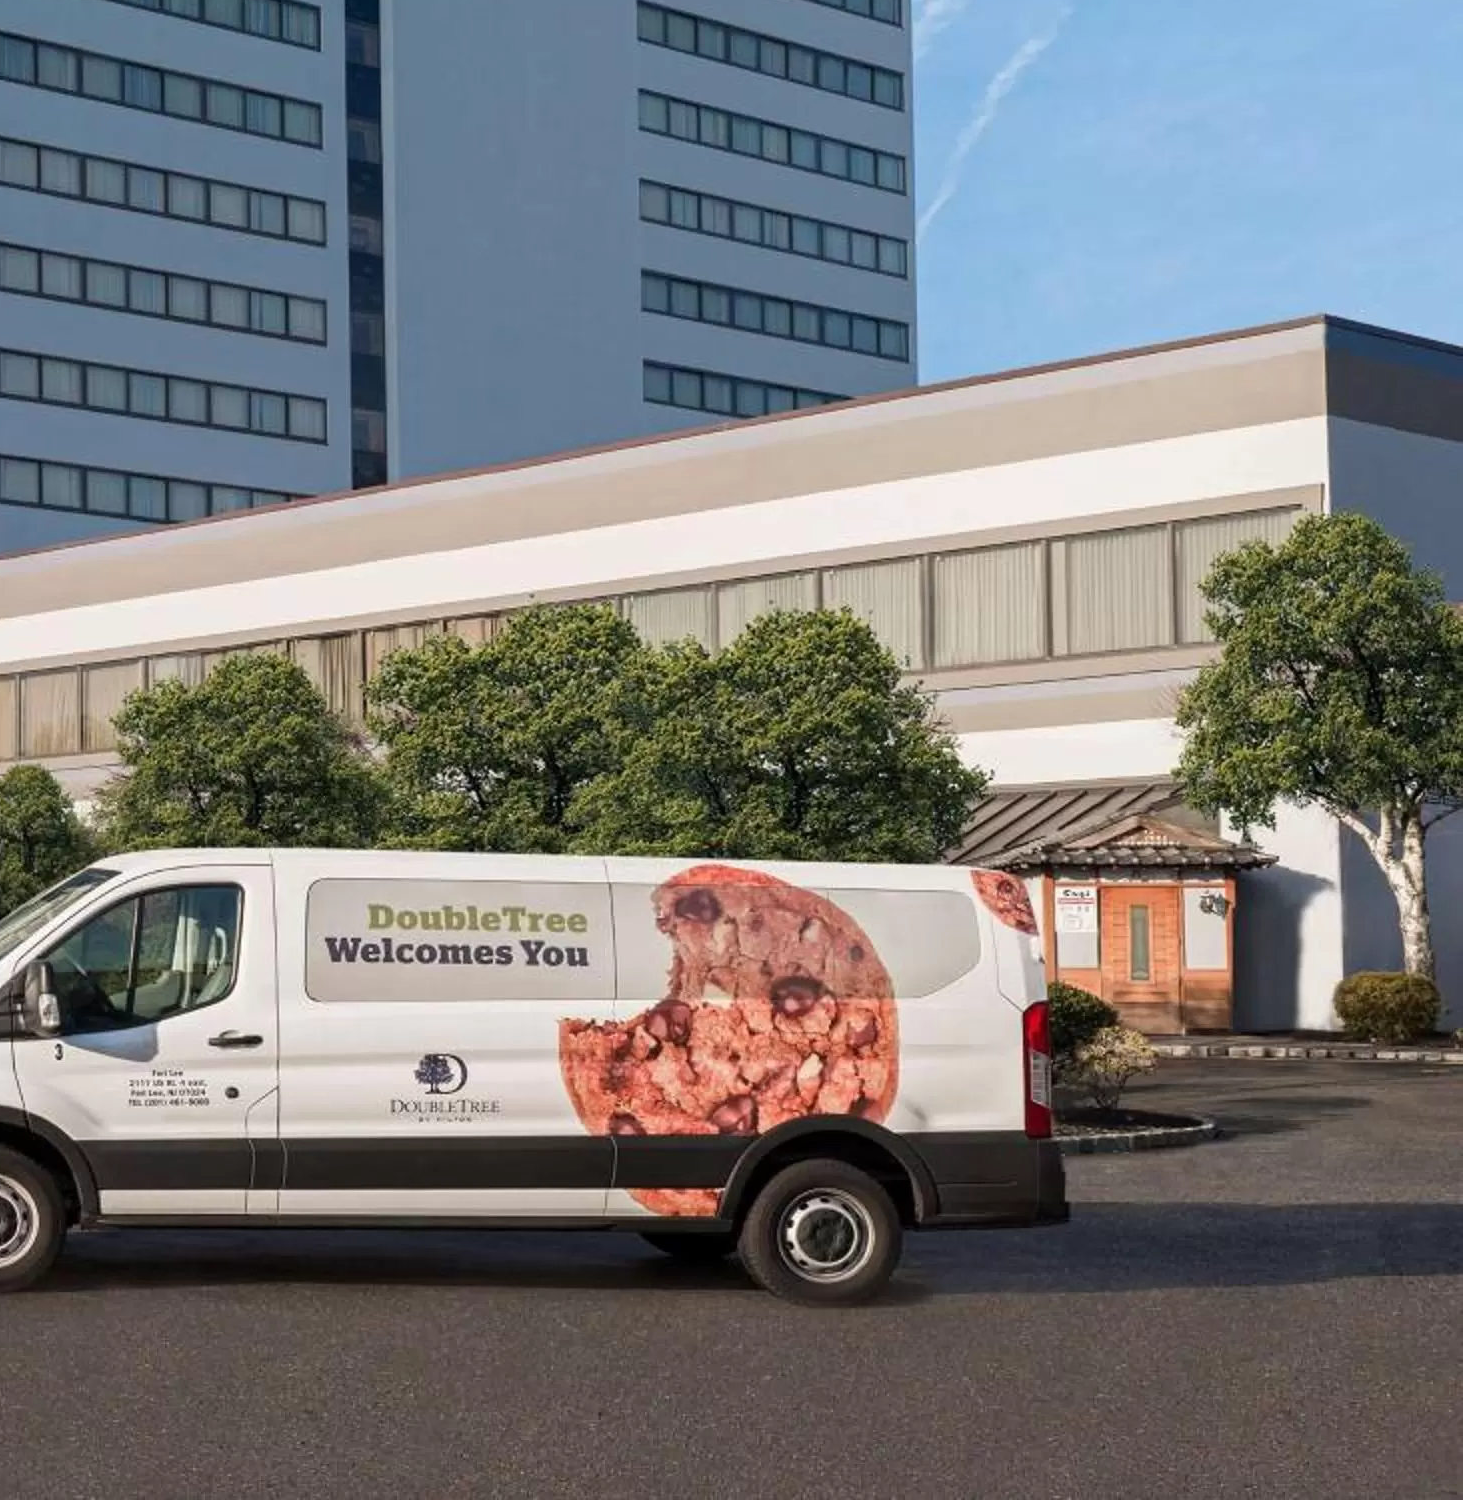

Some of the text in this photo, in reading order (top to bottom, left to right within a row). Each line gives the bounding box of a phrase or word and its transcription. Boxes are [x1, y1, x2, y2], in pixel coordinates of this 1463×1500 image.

[367, 903, 588, 933] DoubleTree
[325, 937, 589, 966] Welcomes You
[54, 1043, 63, 1061] 3
[390, 1099, 501, 1113] DOUBLETREE
